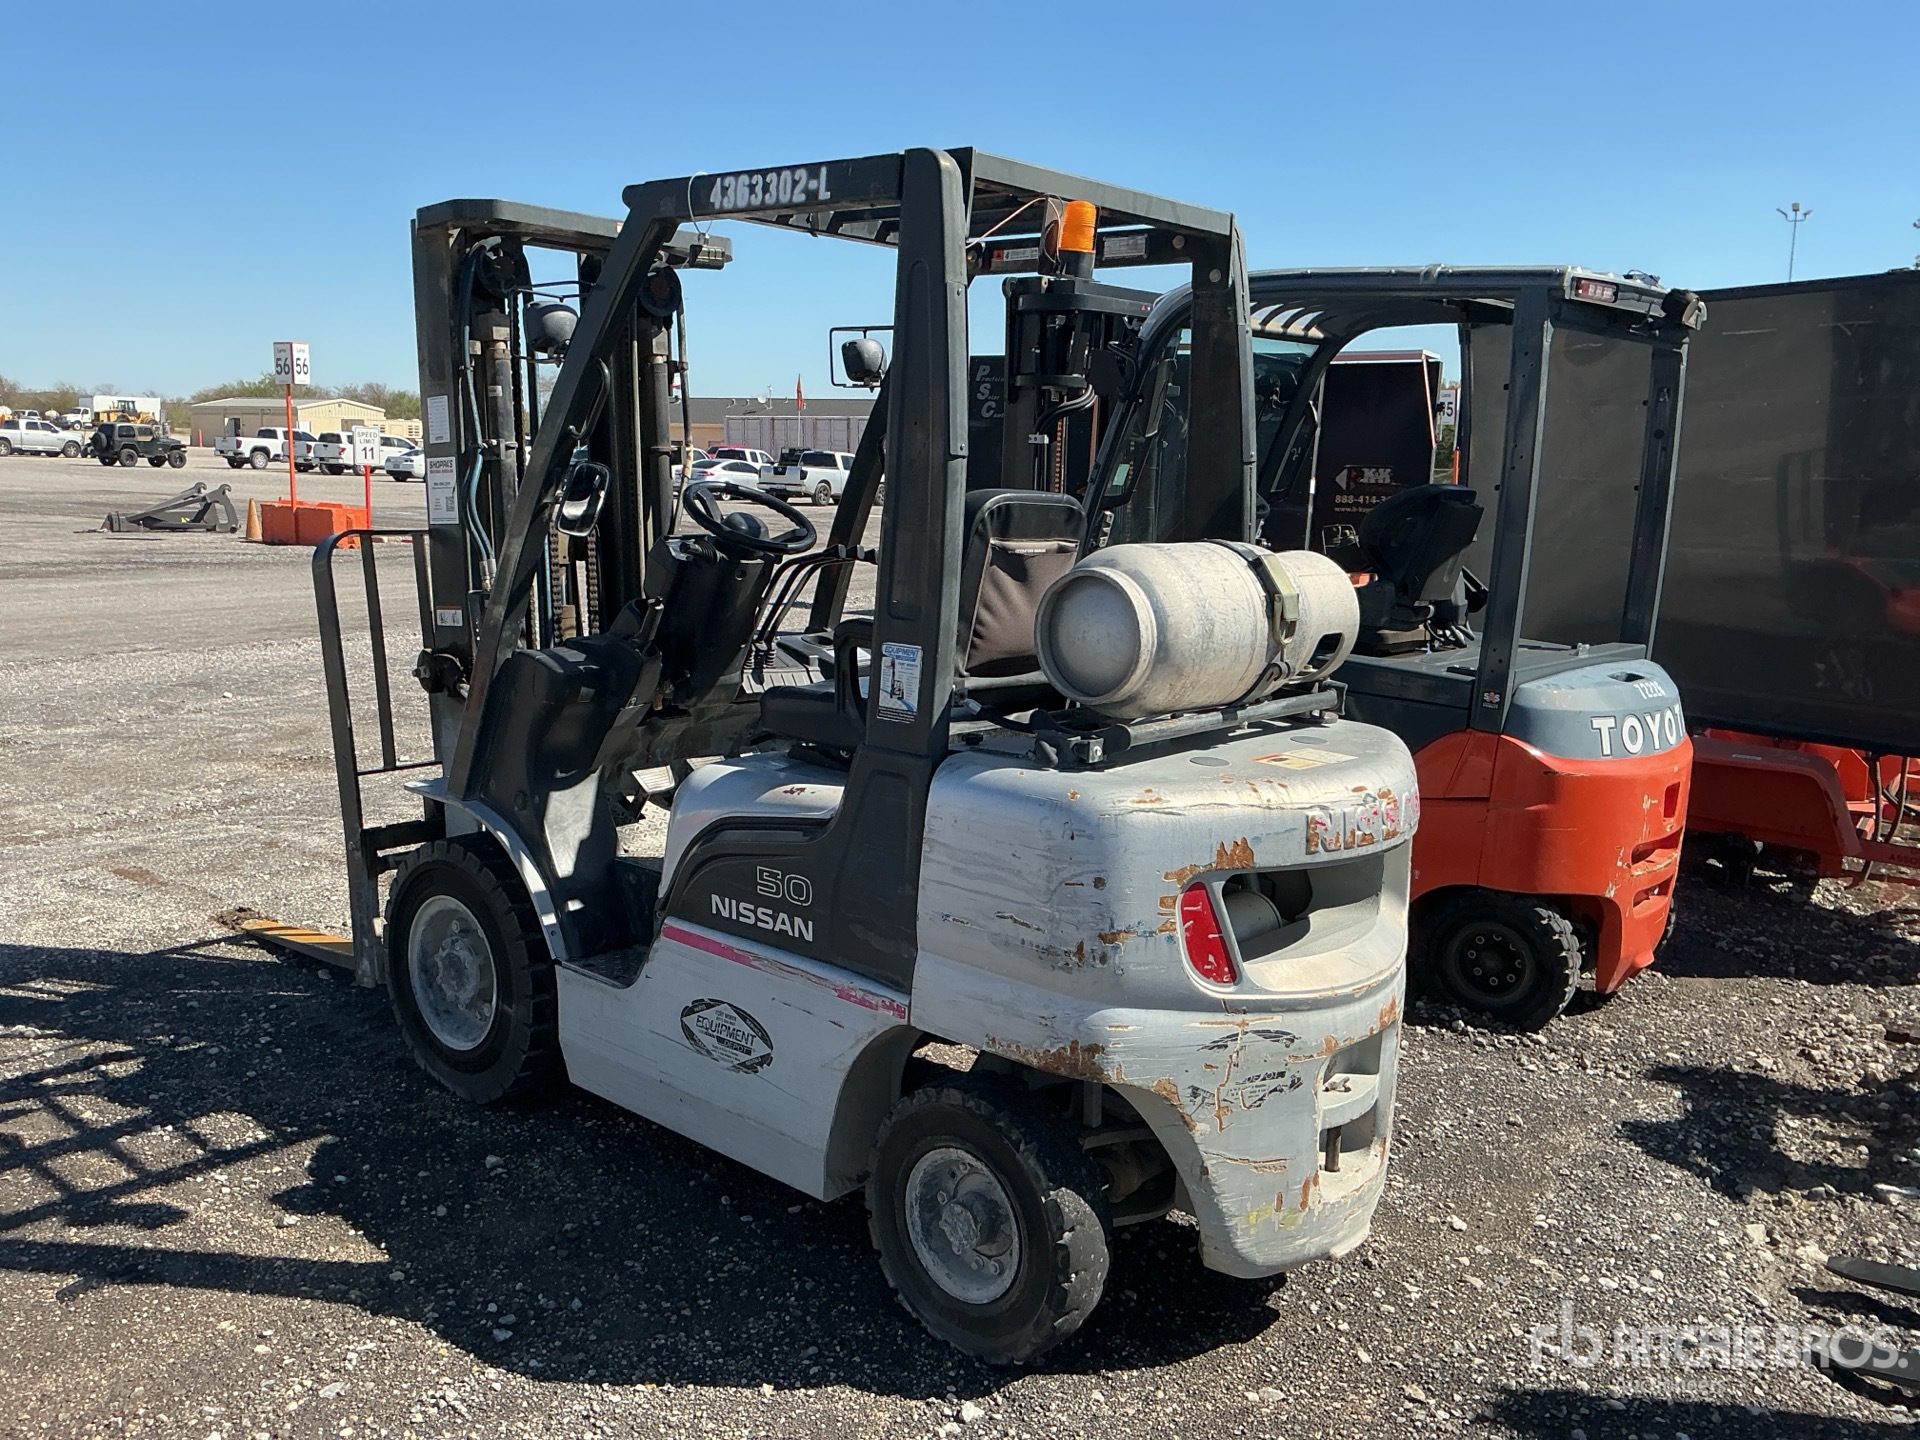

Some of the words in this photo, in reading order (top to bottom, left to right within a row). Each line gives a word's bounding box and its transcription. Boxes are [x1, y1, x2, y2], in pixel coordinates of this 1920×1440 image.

[710, 165, 831, 210] 4363302-L
[275, 357, 291, 375] 56
[295, 357, 309, 375] 56
[361, 446, 375, 460] 11
[884, 645, 919, 658] EQUIPMENT
[1590, 704, 1685, 757] TOYOT
[757, 866, 812, 906] 50
[711, 893, 813, 942] NISSAN
[696, 1015, 757, 1047] EQUIPMENT
[723, 1039, 747, 1053] DEPOT
